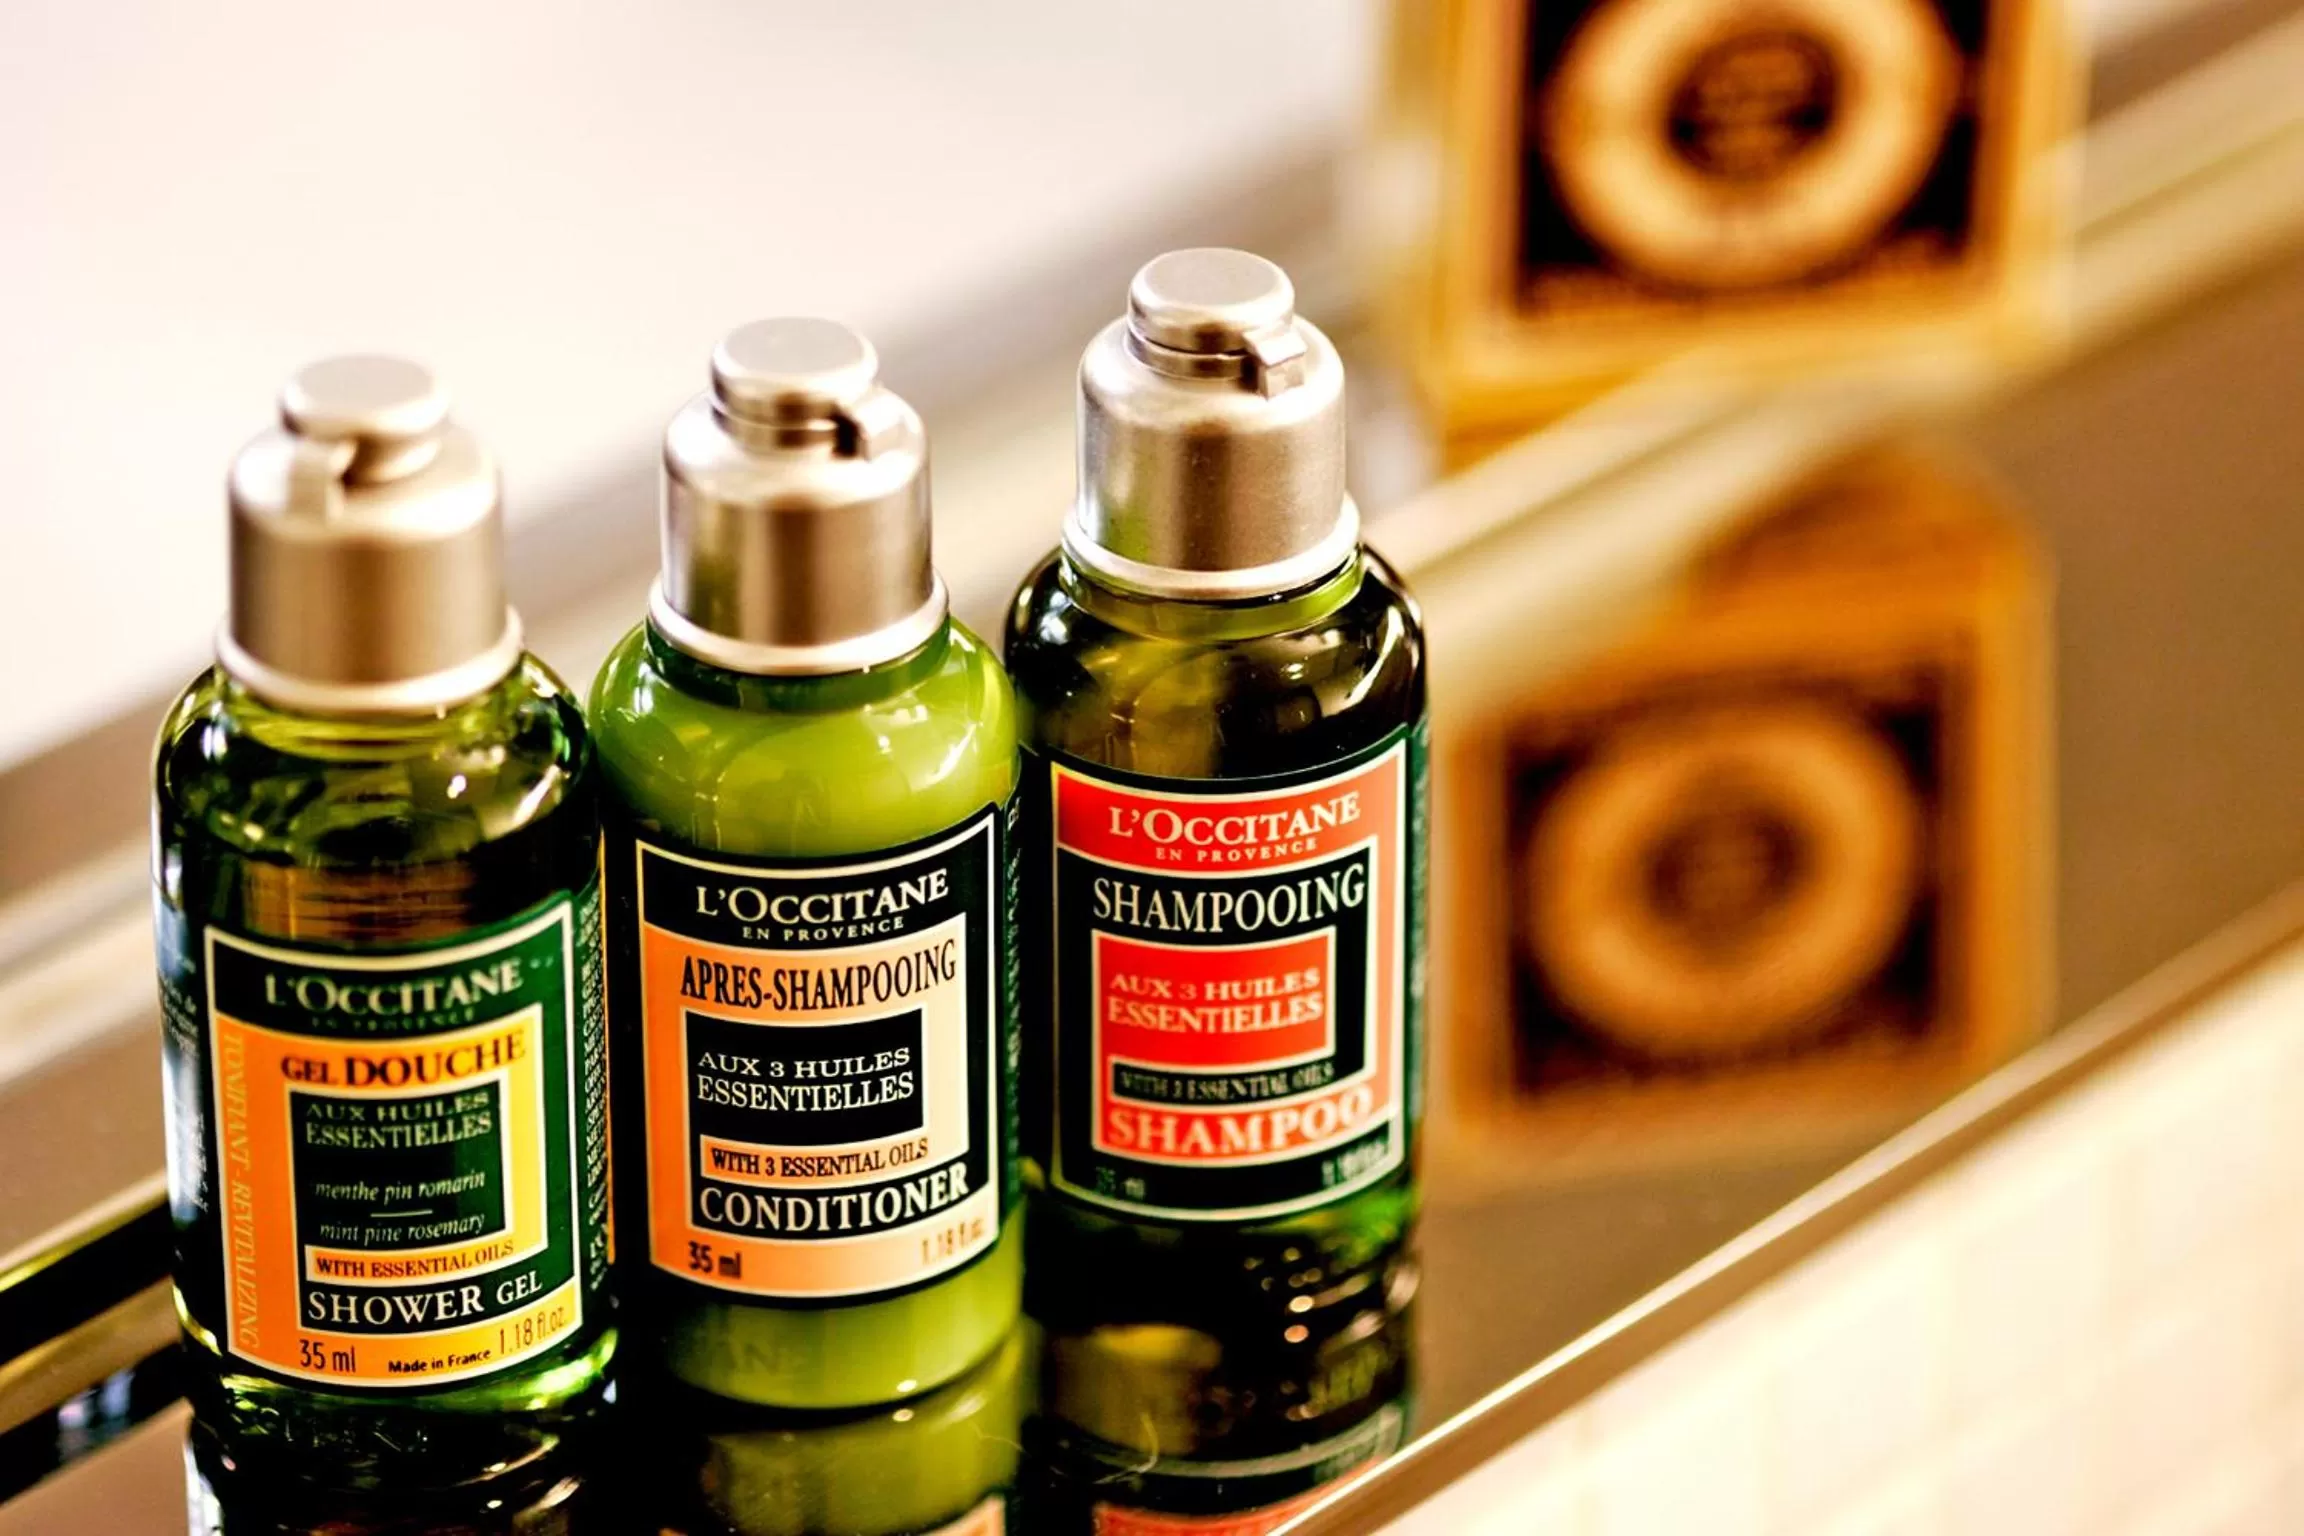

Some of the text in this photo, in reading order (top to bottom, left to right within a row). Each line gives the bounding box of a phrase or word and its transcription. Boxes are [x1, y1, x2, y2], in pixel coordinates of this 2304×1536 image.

[1108, 791, 1361, 846] L'OCCITANE
[1156, 837, 1318, 863] EN PROVENCE
[696, 868, 950, 924] L'OCCITANE
[1093, 862, 1366, 933] SHAMPOOING
[743, 916, 904, 941] EN PROVENCE
[265, 957, 523, 1015] L'OCCITANE
[680, 938, 956, 1011] APRES-SHAMPOOING
[1109, 967, 1320, 1001] AUX 3 HUILES
[1107, 991, 1325, 1034] ESSENTIELLES
[281, 1028, 526, 1087] GEL DOUCHE
[698, 1047, 911, 1078] AUX 3 HUILES
[306, 1091, 490, 1122] AUX HUILES
[697, 1071, 914, 1111] ESSENTIELLES
[306, 1111, 492, 1149] ESSENTIELLES
[1108, 1084, 1374, 1154] SHAMPOO
[711, 1137, 928, 1177] WITH 3 ESSENTIAL OILS
[314, 1169, 486, 1205] menthe pin romarin
[700, 1161, 970, 1231] CONDITIONER
[320, 1213, 485, 1247] mint pine rosemary
[232, 1179, 260, 1350] REVITALIZING
[316, 1239, 514, 1278] WITH ESSENTIAL OILS
[688, 1240, 713, 1273] 35
[308, 1270, 542, 1326] SHOWER GEL
[300, 1339, 356, 1372] 35 ml
[500, 1317, 534, 1356] 1.18
[388, 1349, 491, 1373] Made in France
